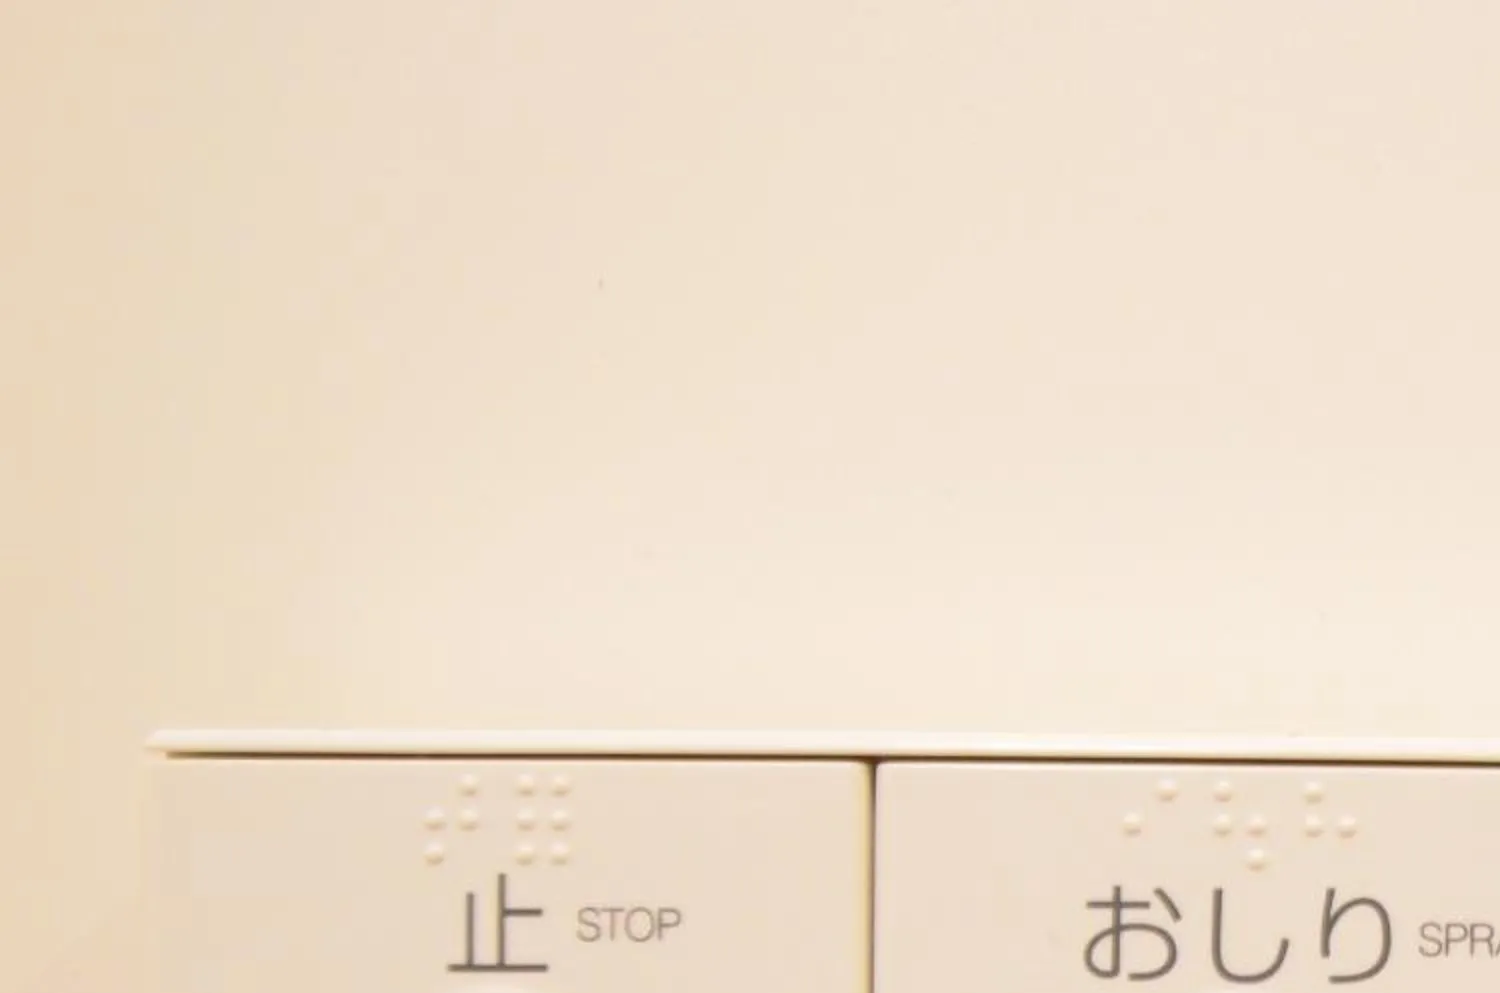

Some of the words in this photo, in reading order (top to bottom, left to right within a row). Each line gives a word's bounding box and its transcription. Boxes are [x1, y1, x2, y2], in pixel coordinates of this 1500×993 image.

[447, 872, 549, 974] 止
[576, 906, 682, 943] STOP
[1083, 884, 1393, 985] おしり
